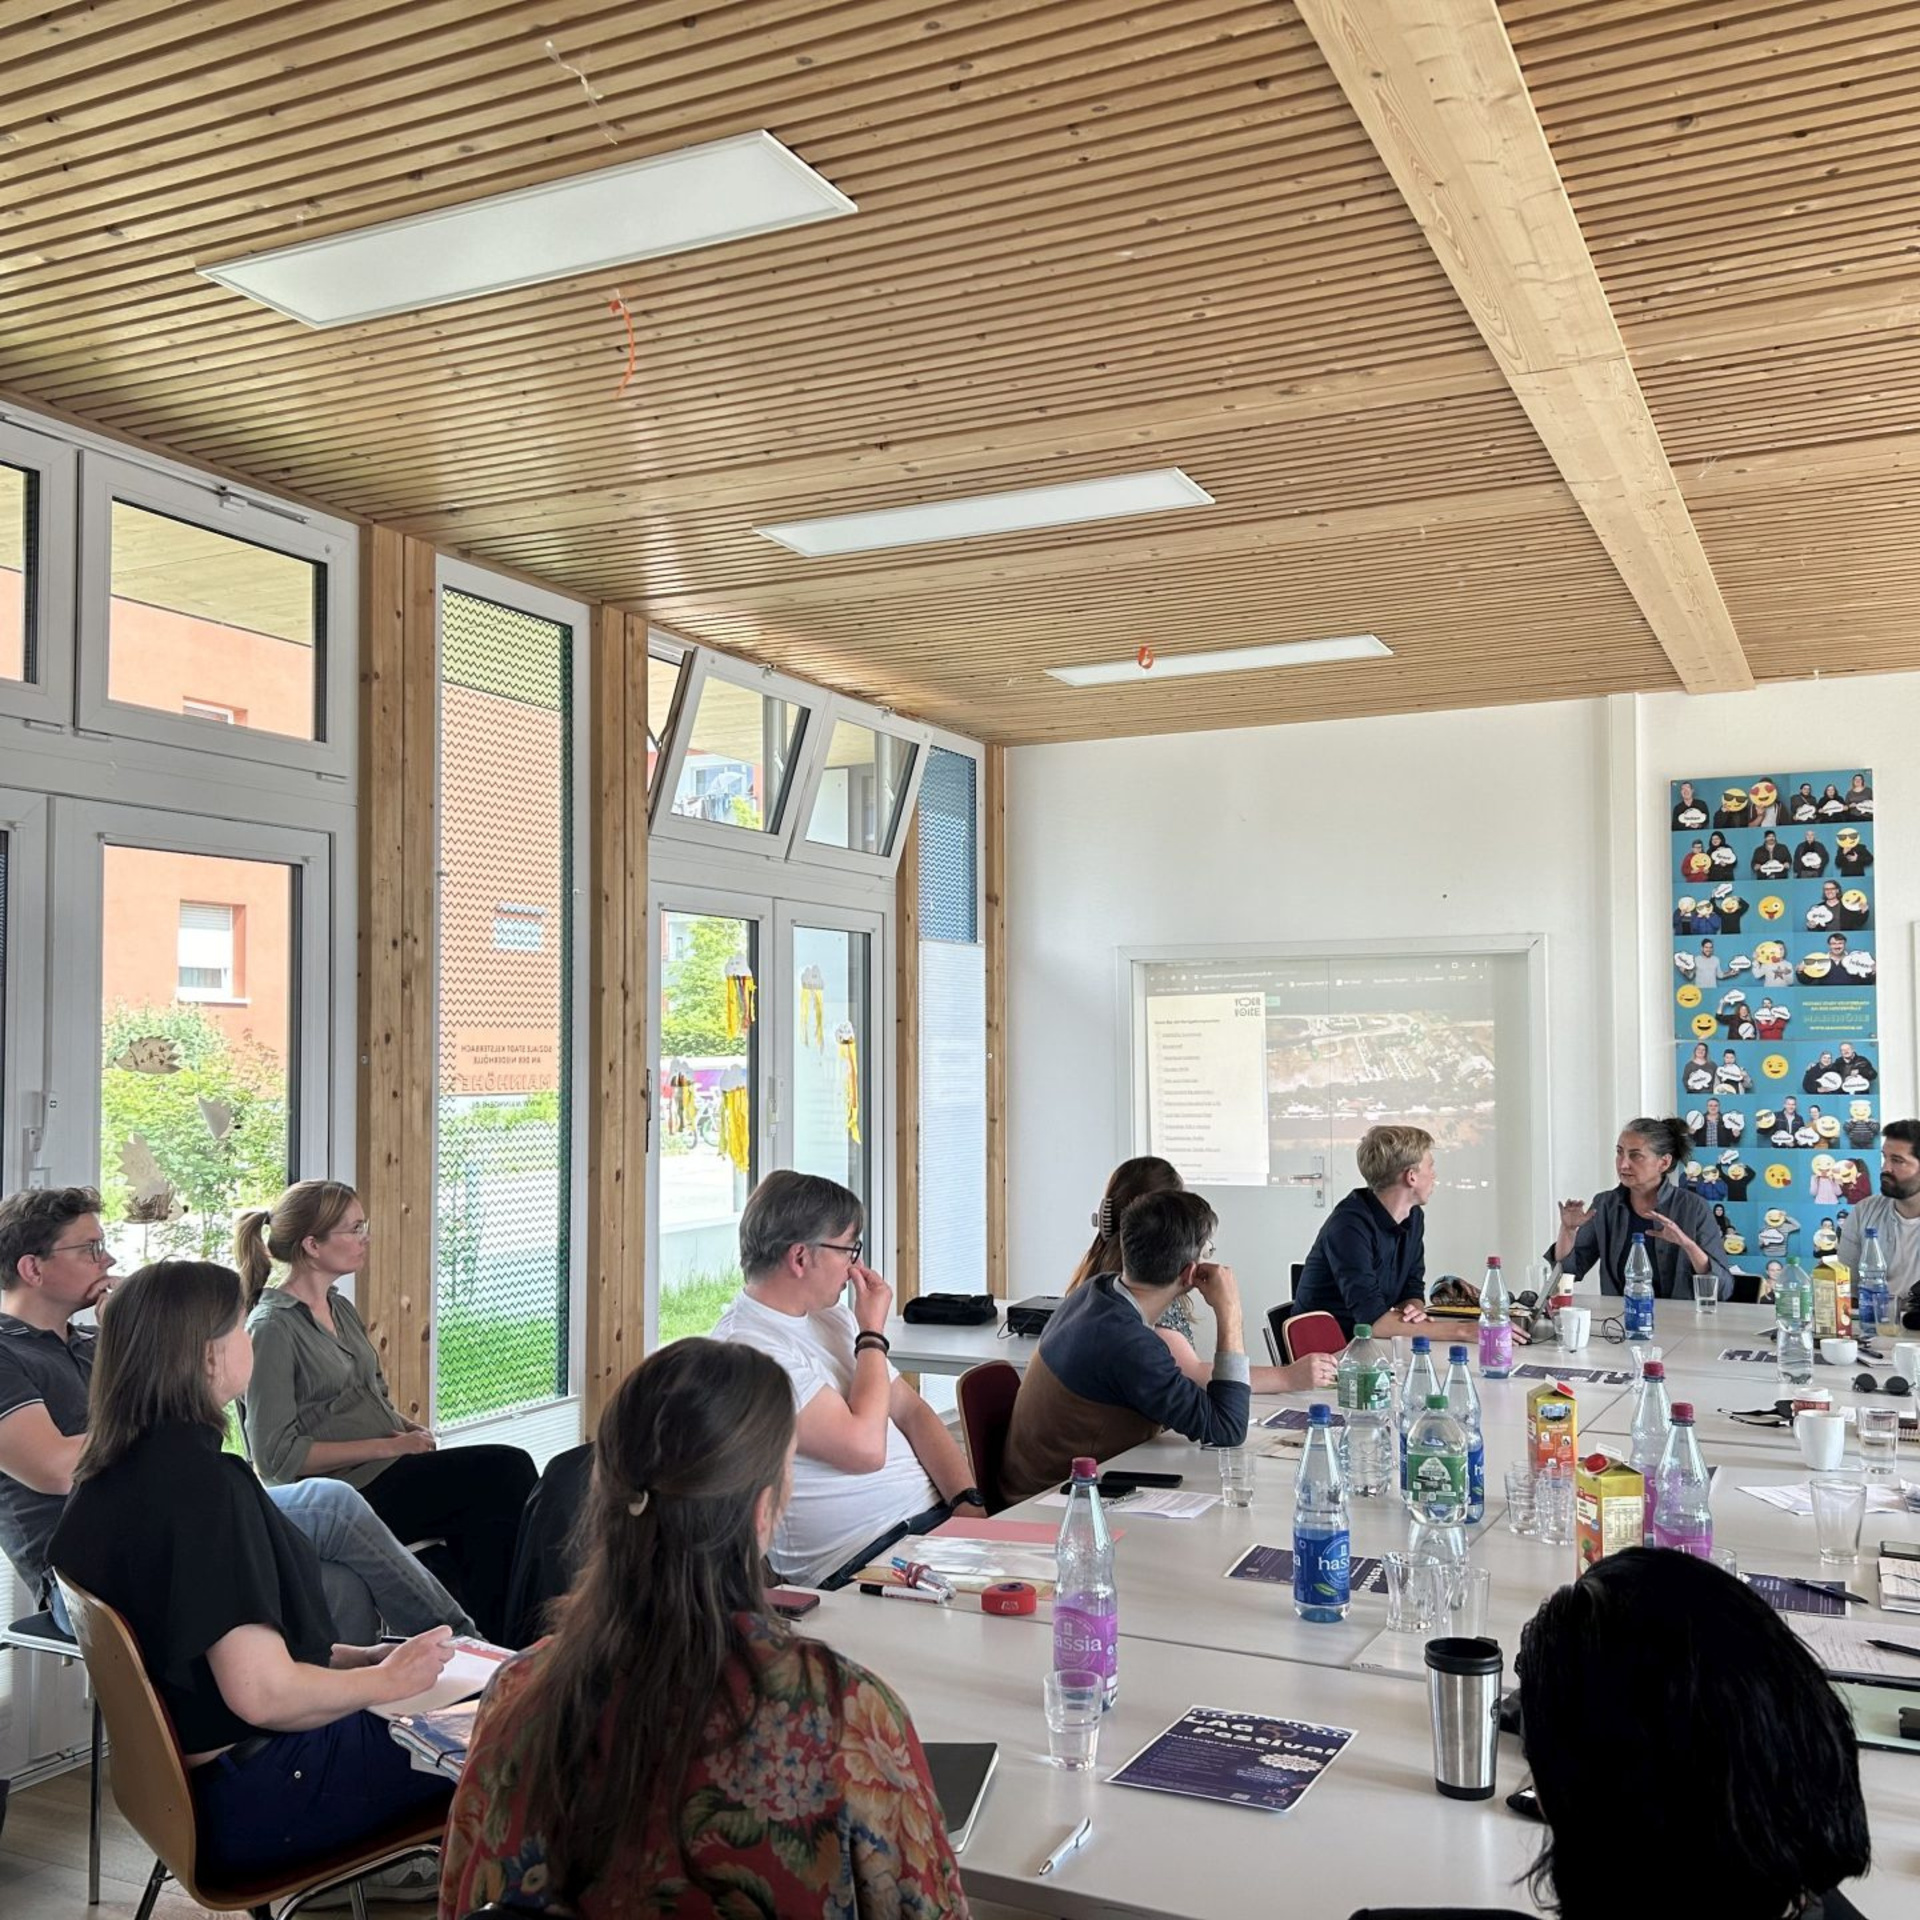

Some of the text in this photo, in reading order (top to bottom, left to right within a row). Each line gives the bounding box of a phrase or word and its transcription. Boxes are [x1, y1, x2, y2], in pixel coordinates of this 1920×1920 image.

[1318, 1556, 1350, 1571] has
[1055, 1635, 1102, 1652] assia
[1183, 1715, 1255, 1733] LAG
[1192, 1726, 1339, 1756] Festival
